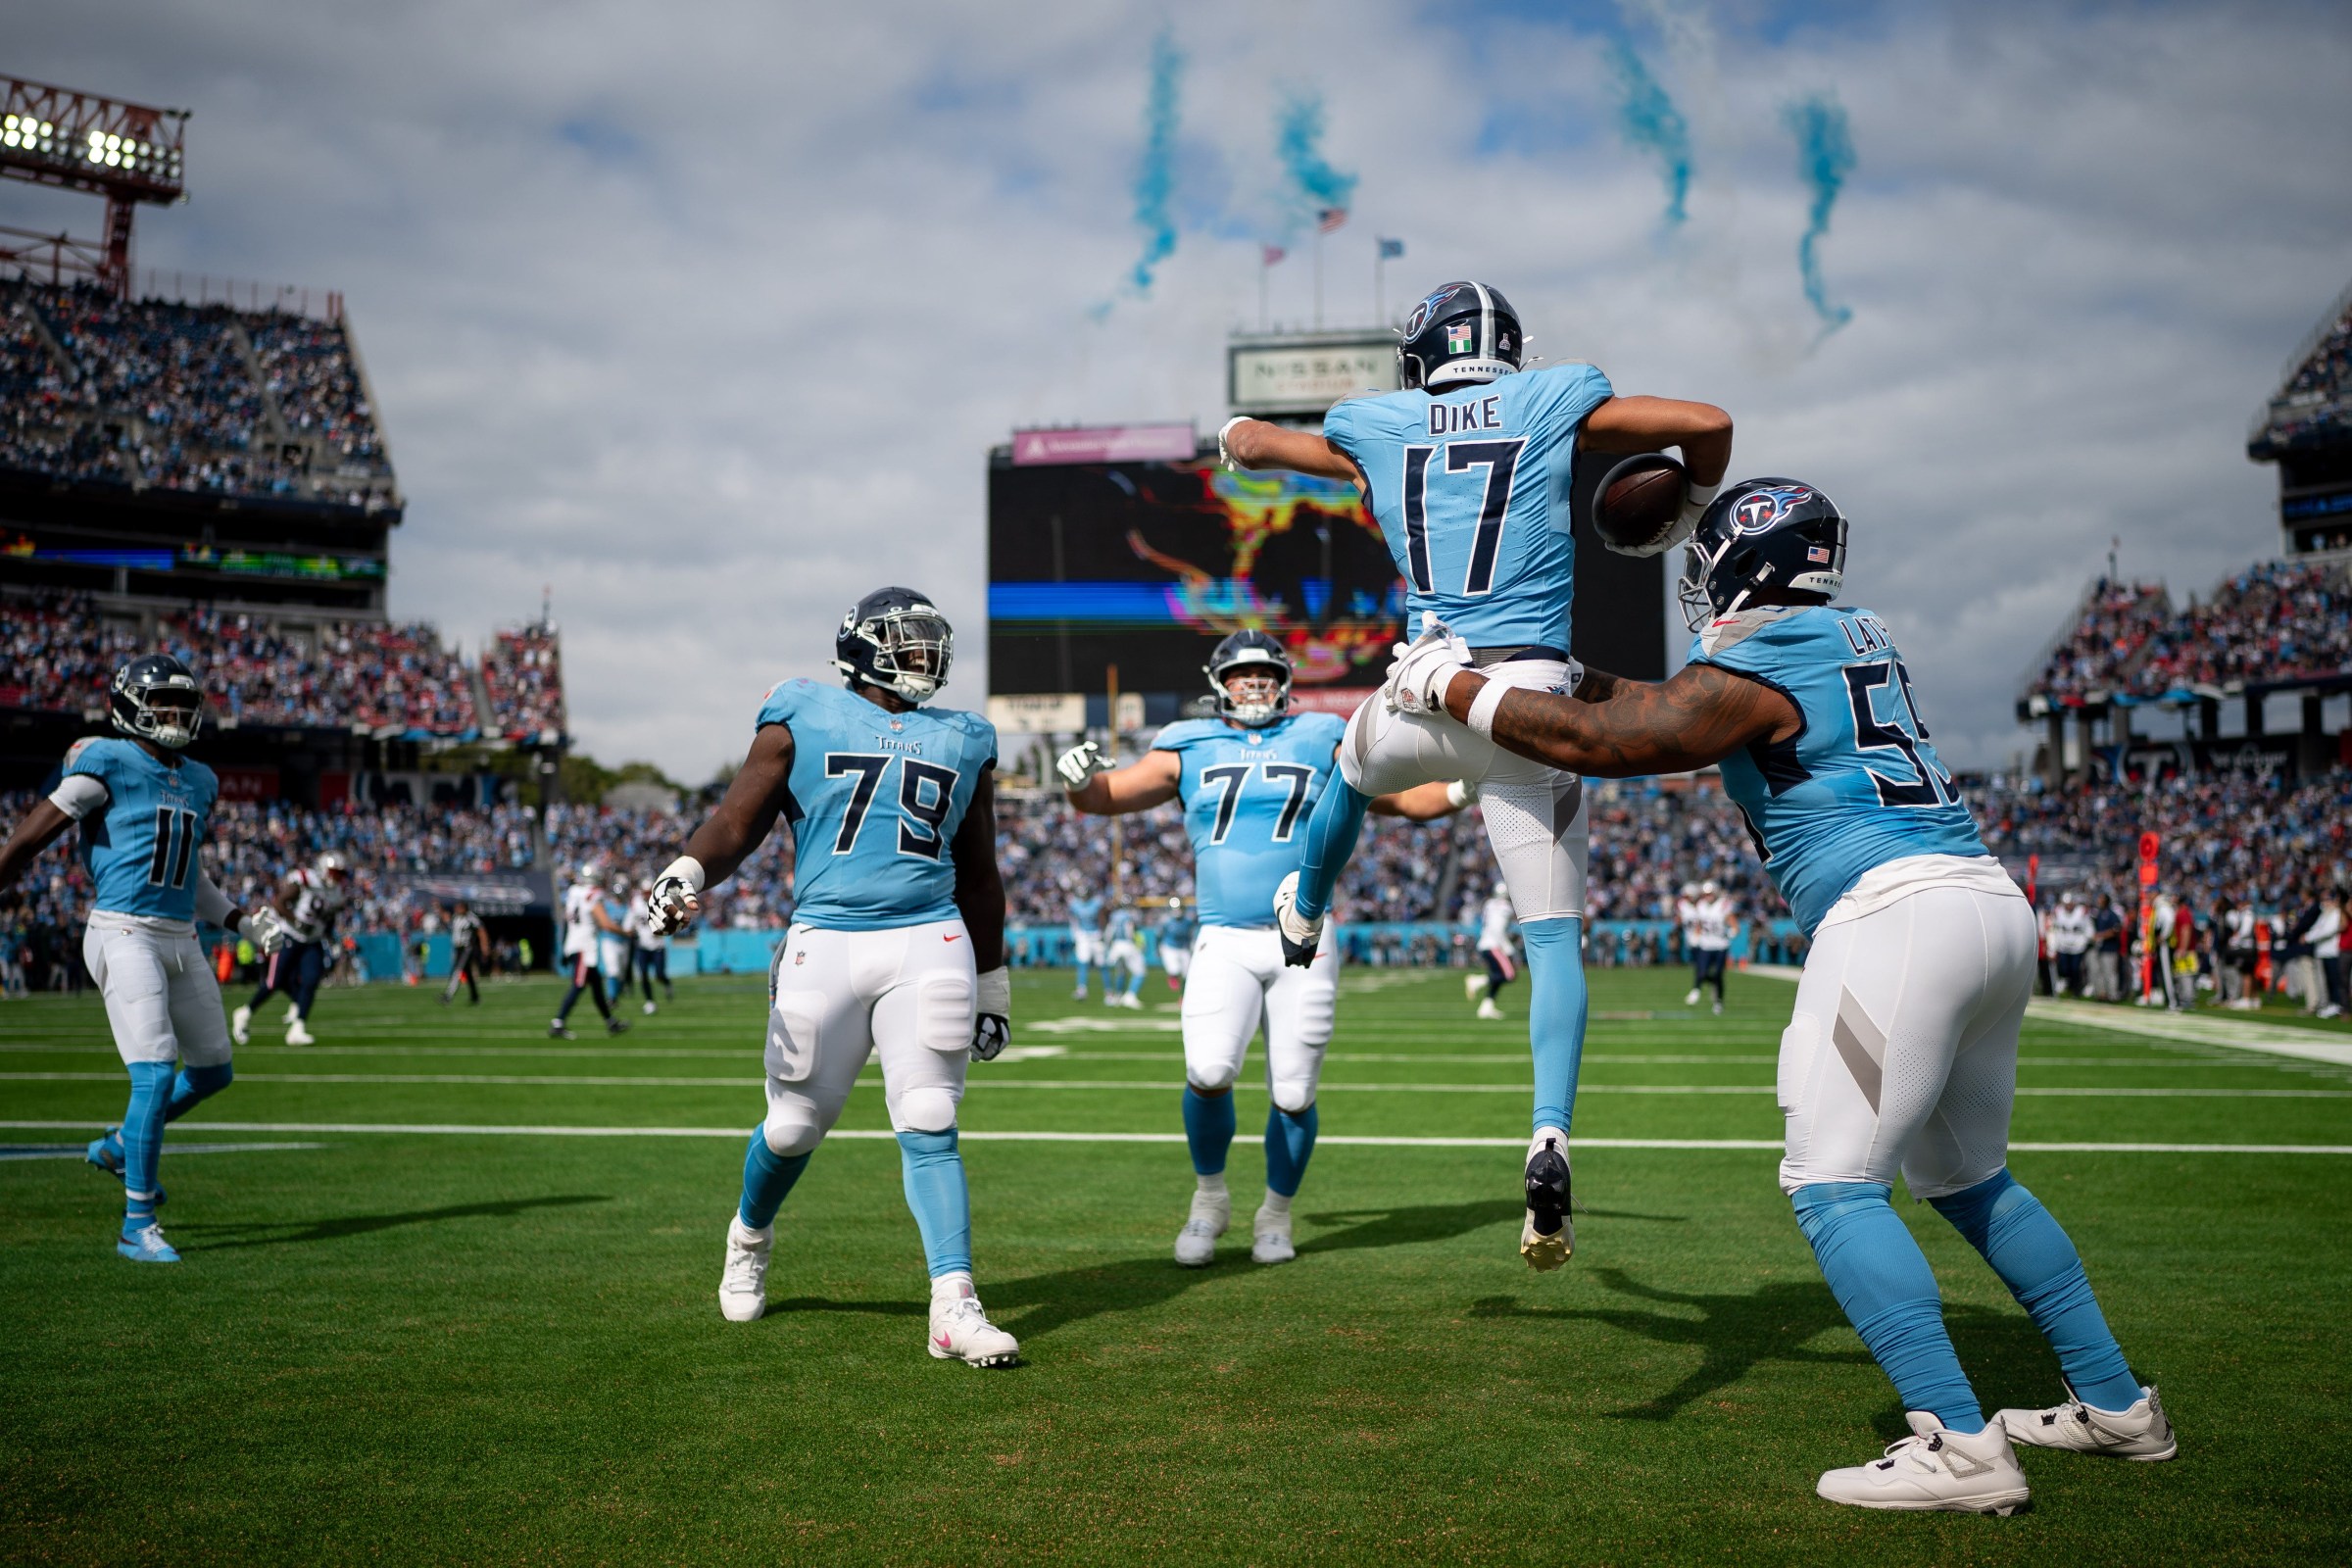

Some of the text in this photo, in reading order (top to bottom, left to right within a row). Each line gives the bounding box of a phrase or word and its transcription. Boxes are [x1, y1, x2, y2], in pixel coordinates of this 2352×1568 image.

[1428, 394, 1502, 437] DIKE
[1402, 435, 1530, 597] 17
[1740, 501, 1772, 526] T
[824, 752, 960, 862] 79
[1200, 761, 1316, 845] 77
[148, 805, 198, 890] 11
